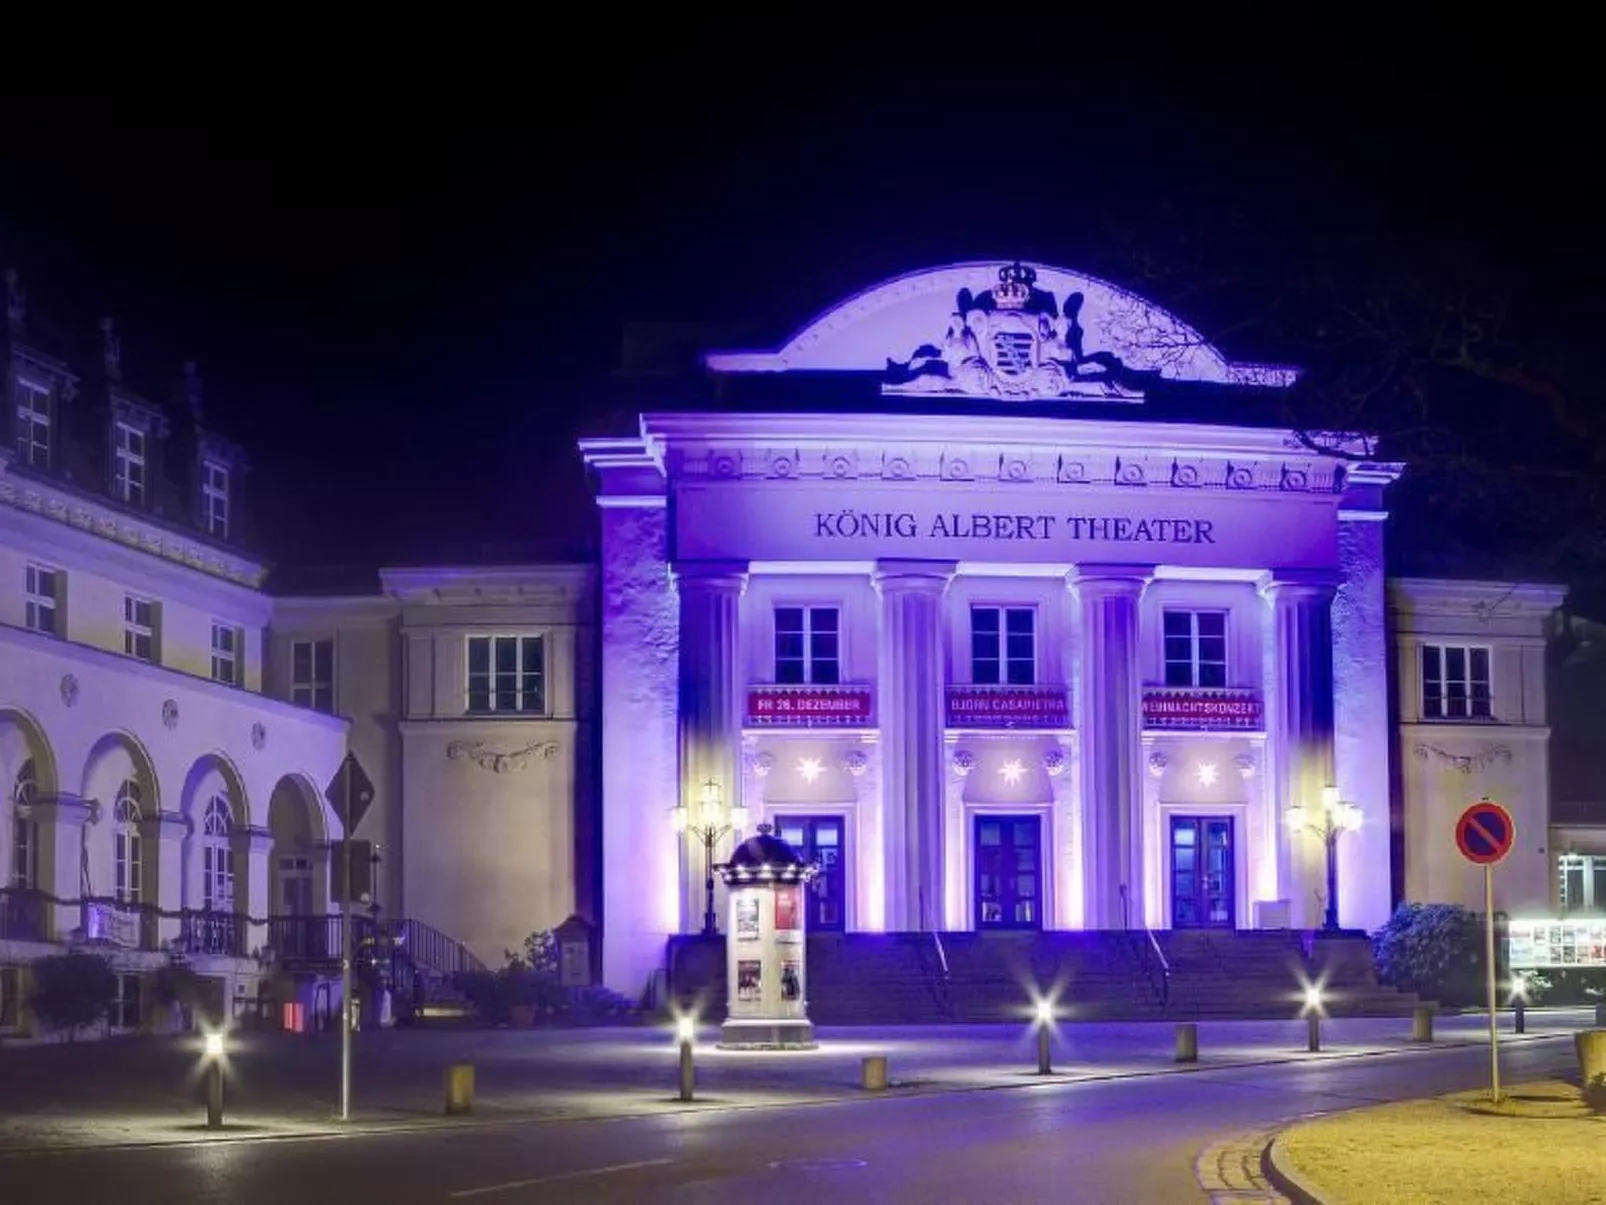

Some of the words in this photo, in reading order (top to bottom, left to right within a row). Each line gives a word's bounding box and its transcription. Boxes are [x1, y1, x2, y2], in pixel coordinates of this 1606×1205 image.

[815, 510, 917, 537] KÖNIG
[930, 513, 1056, 539] ALBERT
[1067, 517, 1215, 543] THEATER
[797, 699, 860, 710] DEZEMBER
